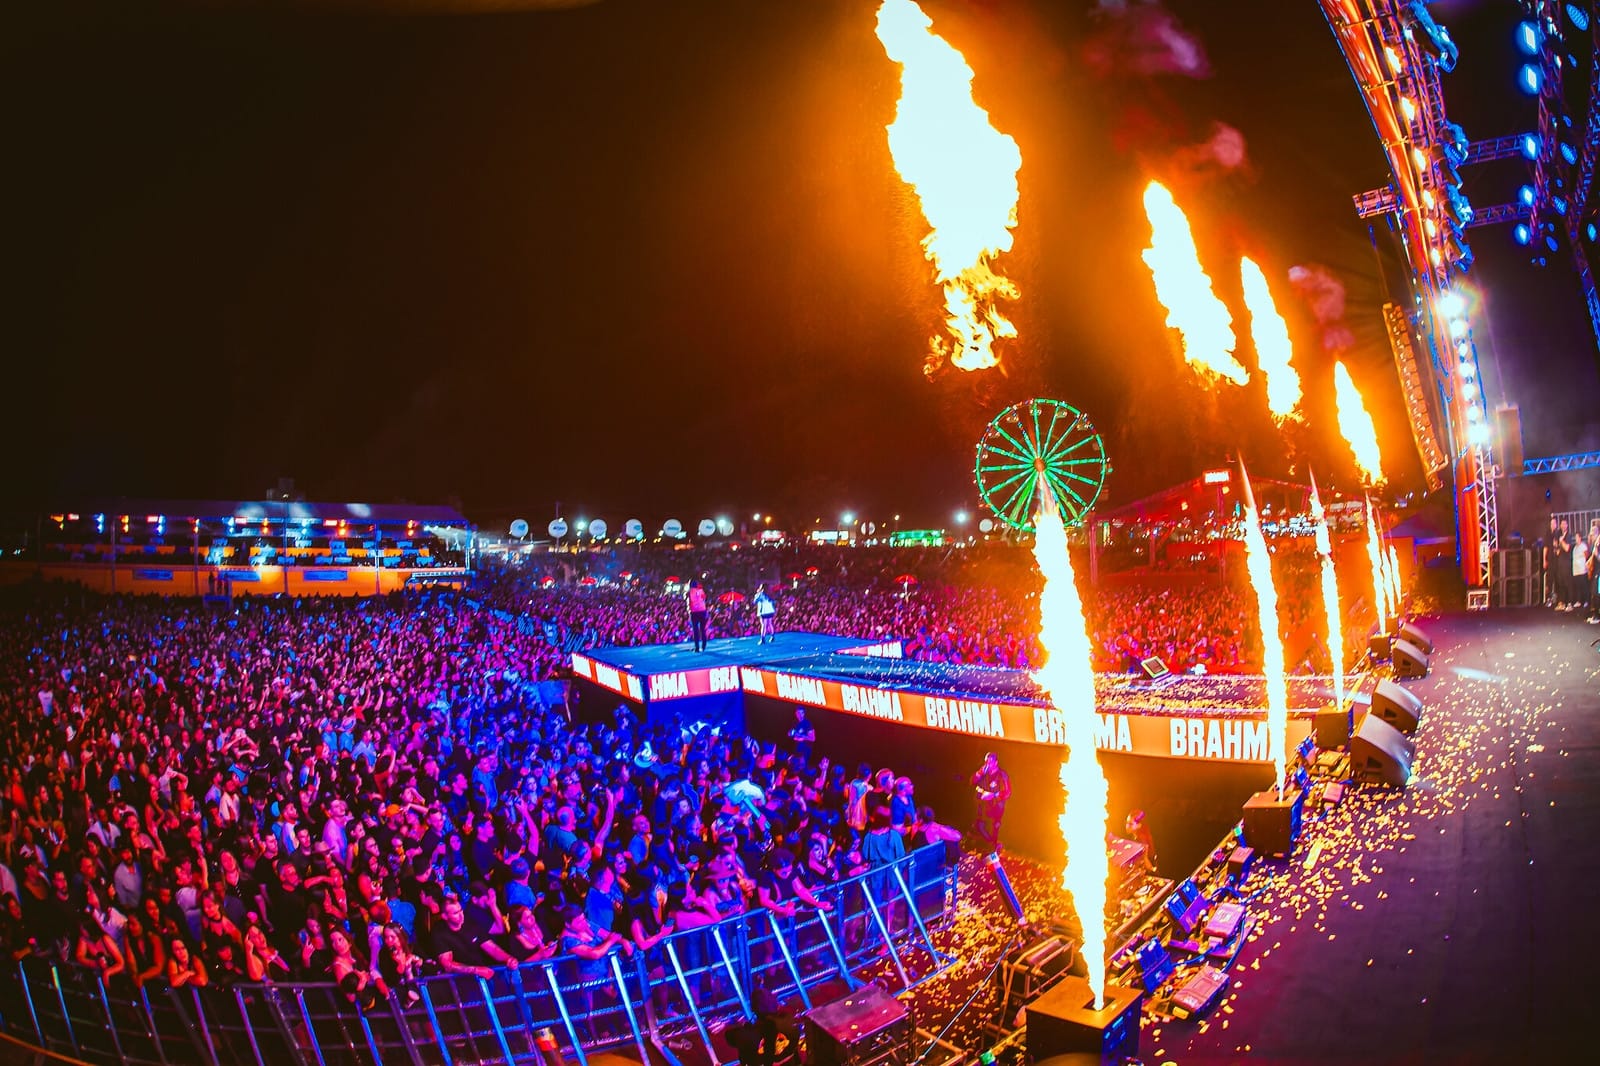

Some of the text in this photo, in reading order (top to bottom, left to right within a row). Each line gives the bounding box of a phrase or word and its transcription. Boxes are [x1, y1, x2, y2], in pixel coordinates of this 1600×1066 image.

[650, 671, 688, 699] HMA
[841, 683, 904, 721] BRAHMA
[924, 696, 1005, 738] BRAHMA
